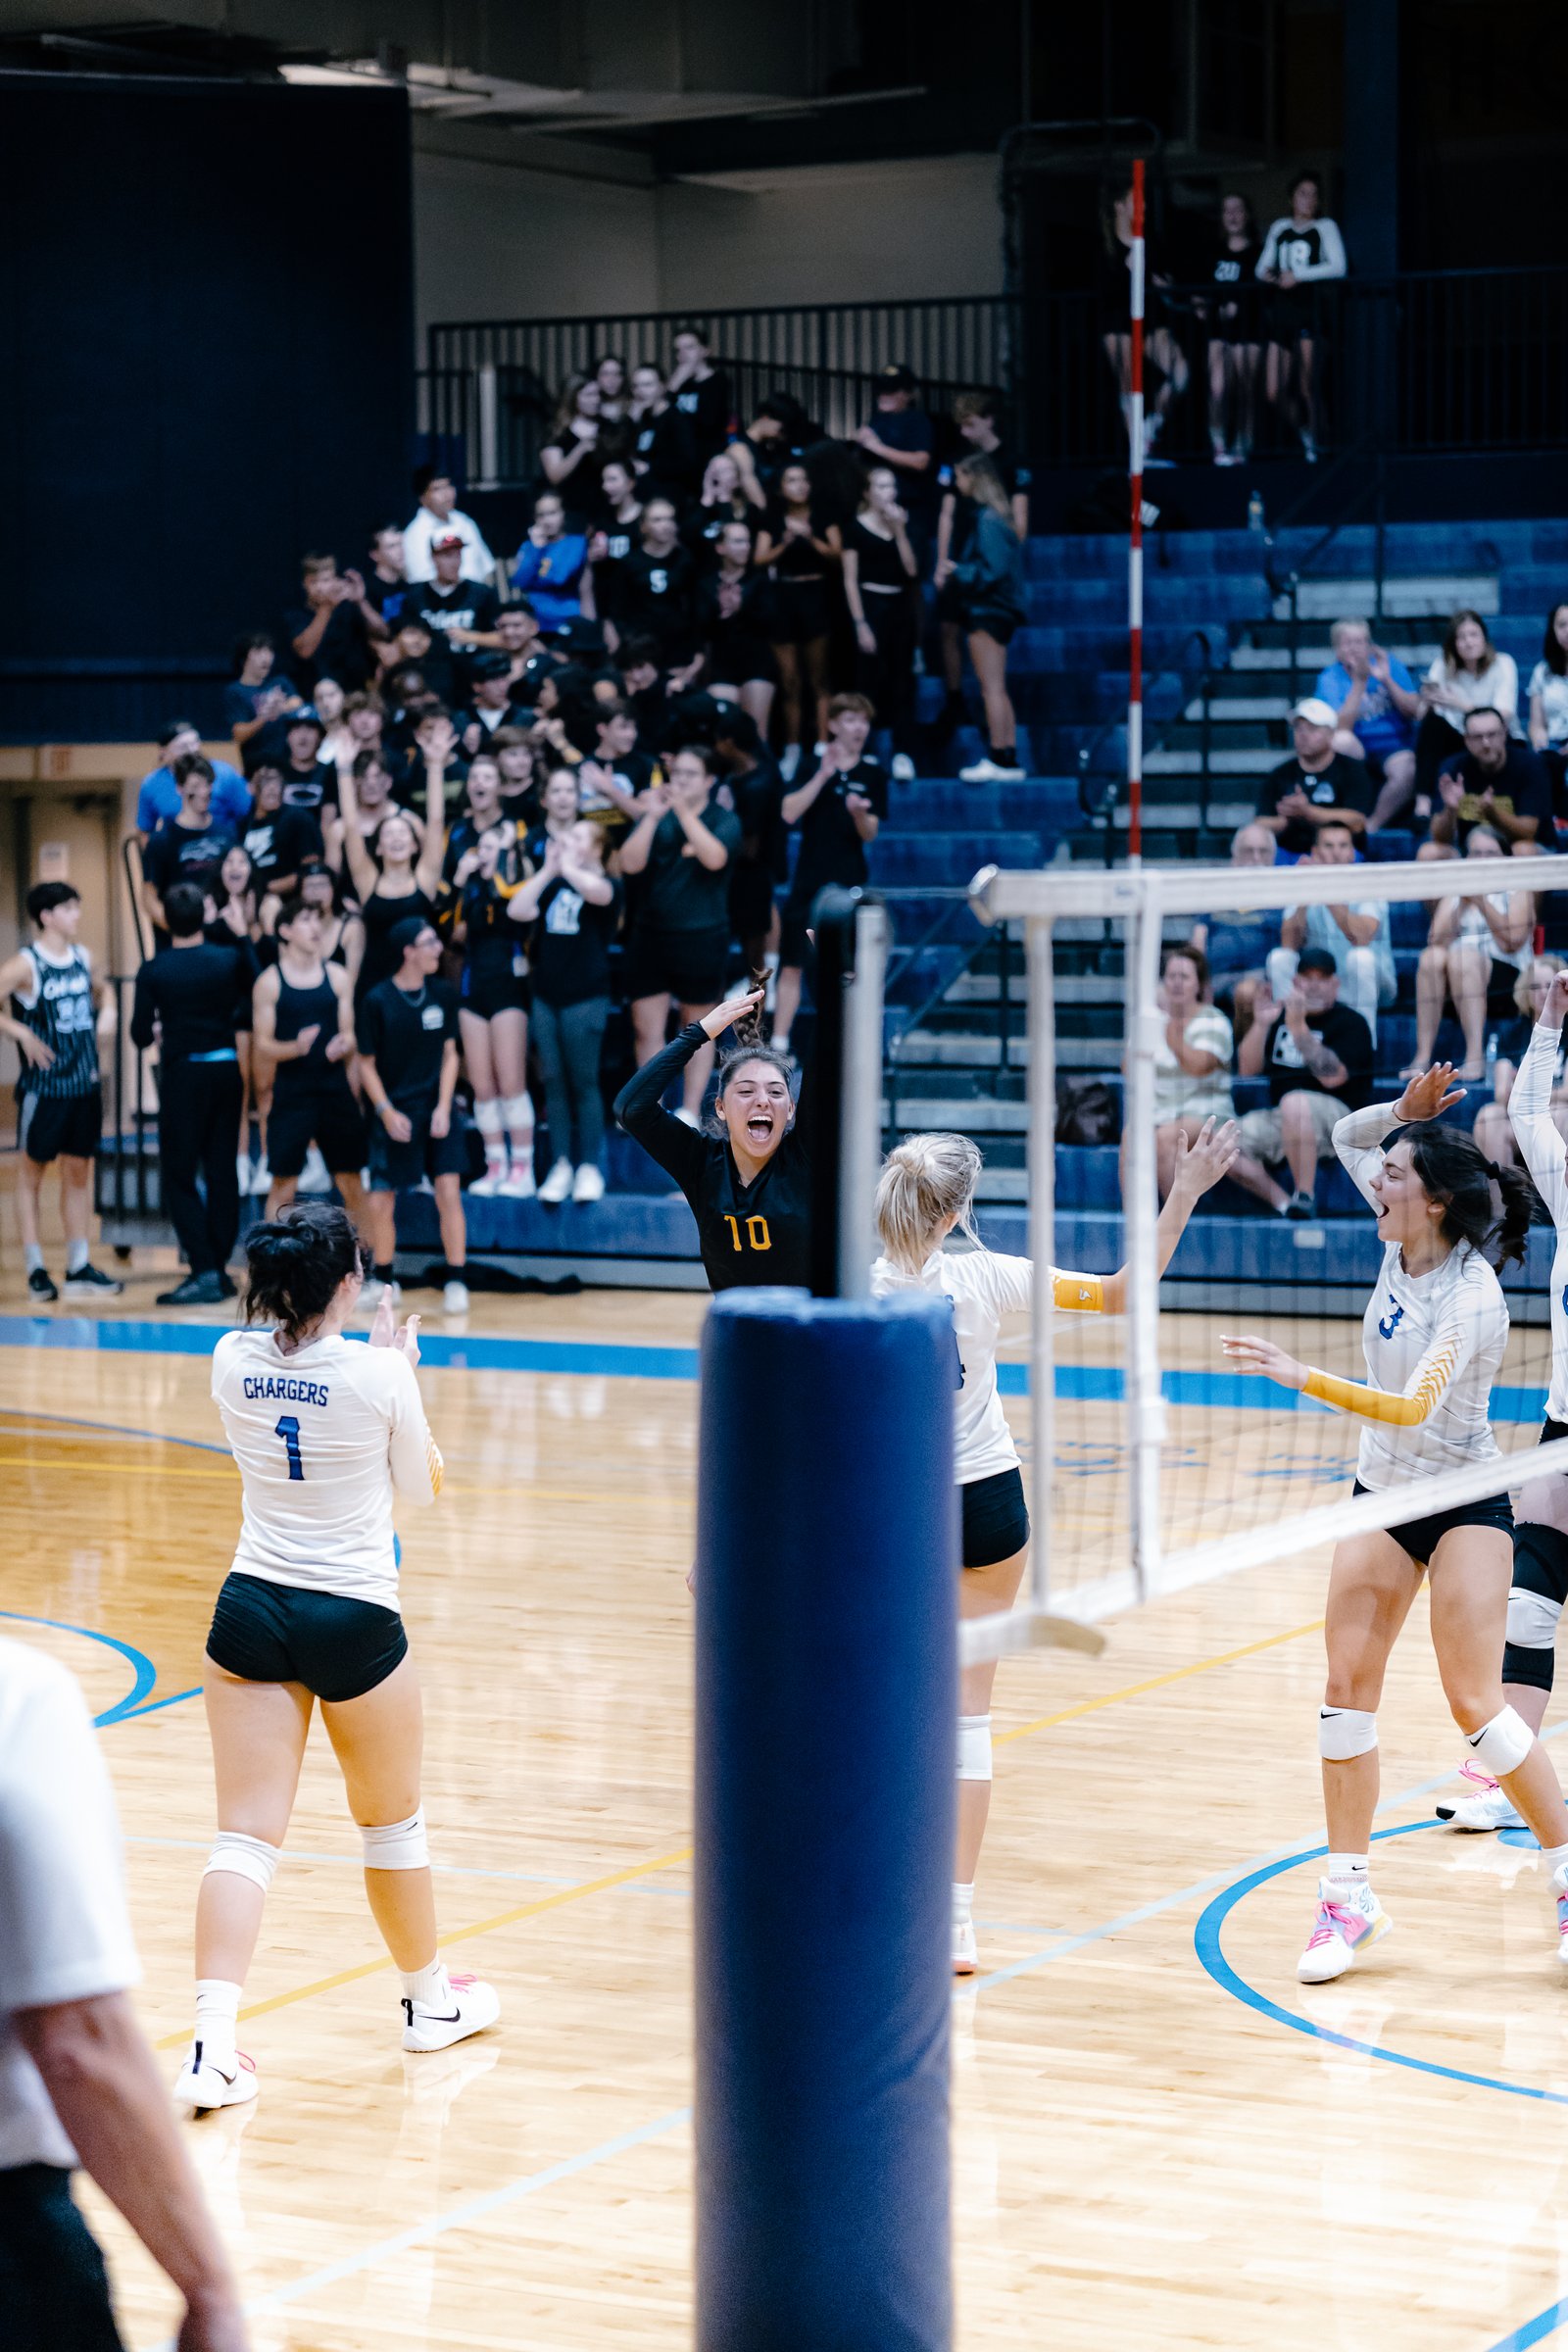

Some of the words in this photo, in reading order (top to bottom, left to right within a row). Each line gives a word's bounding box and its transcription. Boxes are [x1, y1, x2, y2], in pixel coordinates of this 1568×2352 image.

[724, 1215, 772, 1251] 10
[1379, 1294, 1404, 1340] 3
[243, 1377, 329, 1406] CHARGERS
[274, 1415, 306, 1481] 1
